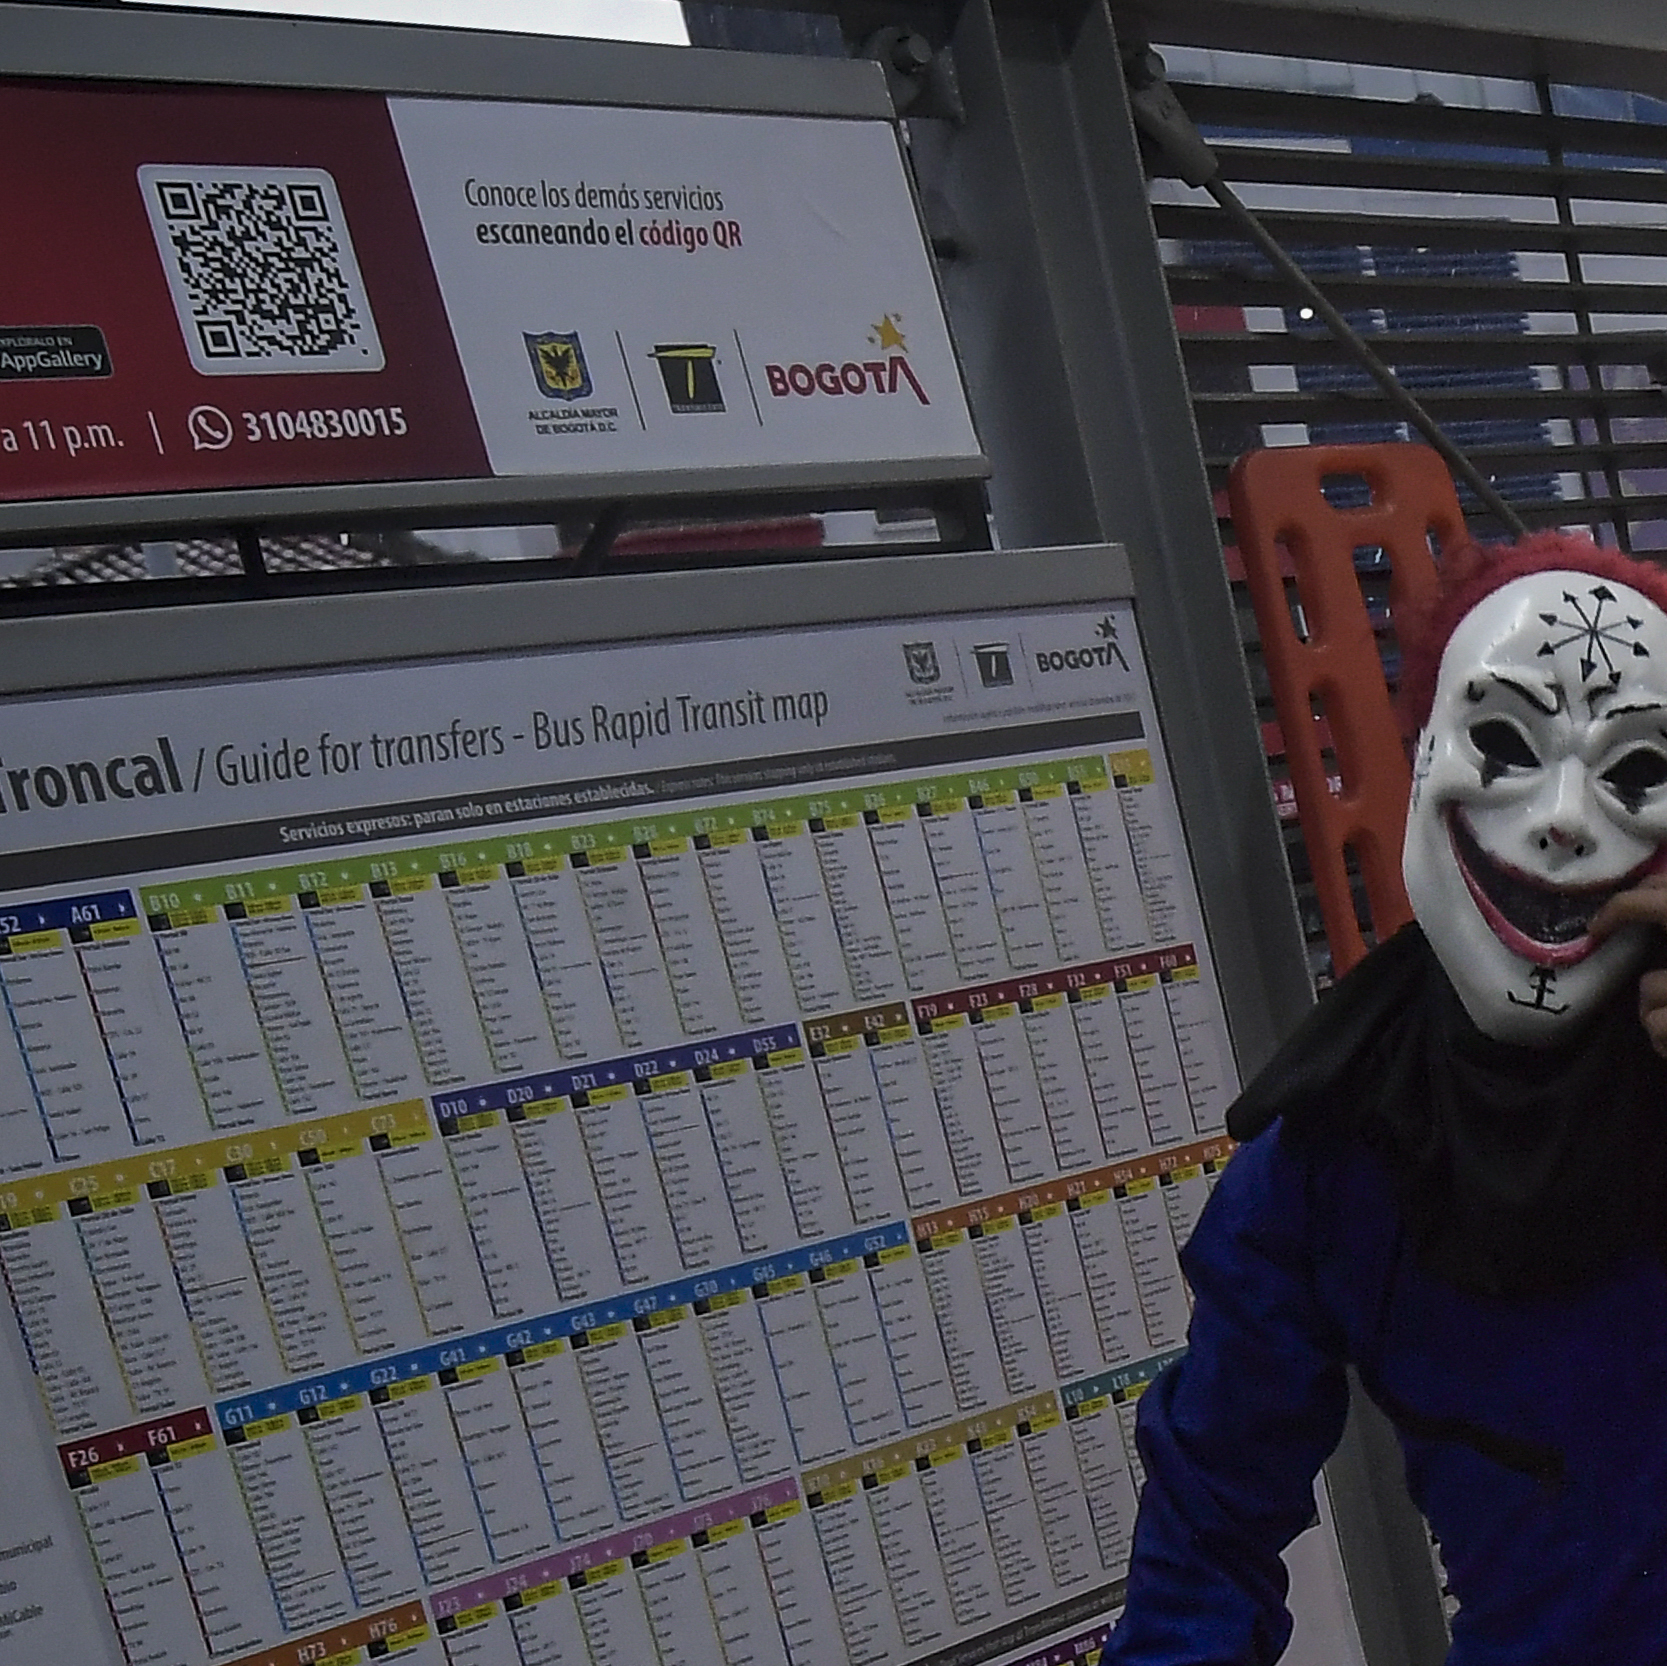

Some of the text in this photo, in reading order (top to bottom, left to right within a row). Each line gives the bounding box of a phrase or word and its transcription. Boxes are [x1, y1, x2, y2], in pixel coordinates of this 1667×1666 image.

[465, 178, 724, 211] Conoce los demás servicios
[476, 218, 743, 253] escaneando el código QR
[1, 349, 101, 372] AppGallery
[242, 407, 408, 442] 3104830015
[535, 423, 550, 434] DE
[581, 407, 618, 419] MAYOR
[2, 420, 124, 457] a 11 p.m.
[0, 737, 183, 813] roncal
[216, 738, 311, 787] Guide
[318, 733, 362, 775] for
[371, 720, 505, 769] transfers
[533, 711, 584, 750] Bus
[593, 698, 671, 748] Rapid
[677, 690, 765, 732] Transit
[773, 689, 829, 729] map
[280, 822, 344, 843] Servicios
[346, 815, 412, 836] expresos:
[415, 808, 454, 828] paran
[456, 801, 483, 820] solo
[486, 801, 503, 815] en
[506, 793, 572, 812] estaciones
[0, 905, 101, 934] 52 A61
[440, 1100, 468, 1118] D10
[506, 1086, 534, 1104] D20
[694, 1048, 720, 1065] D24
[225, 1405, 253, 1425] G11
[300, 1385, 329, 1405] G12
[68, 1426, 177, 1467] F26 F61
[297, 1641, 327, 1663] H73
